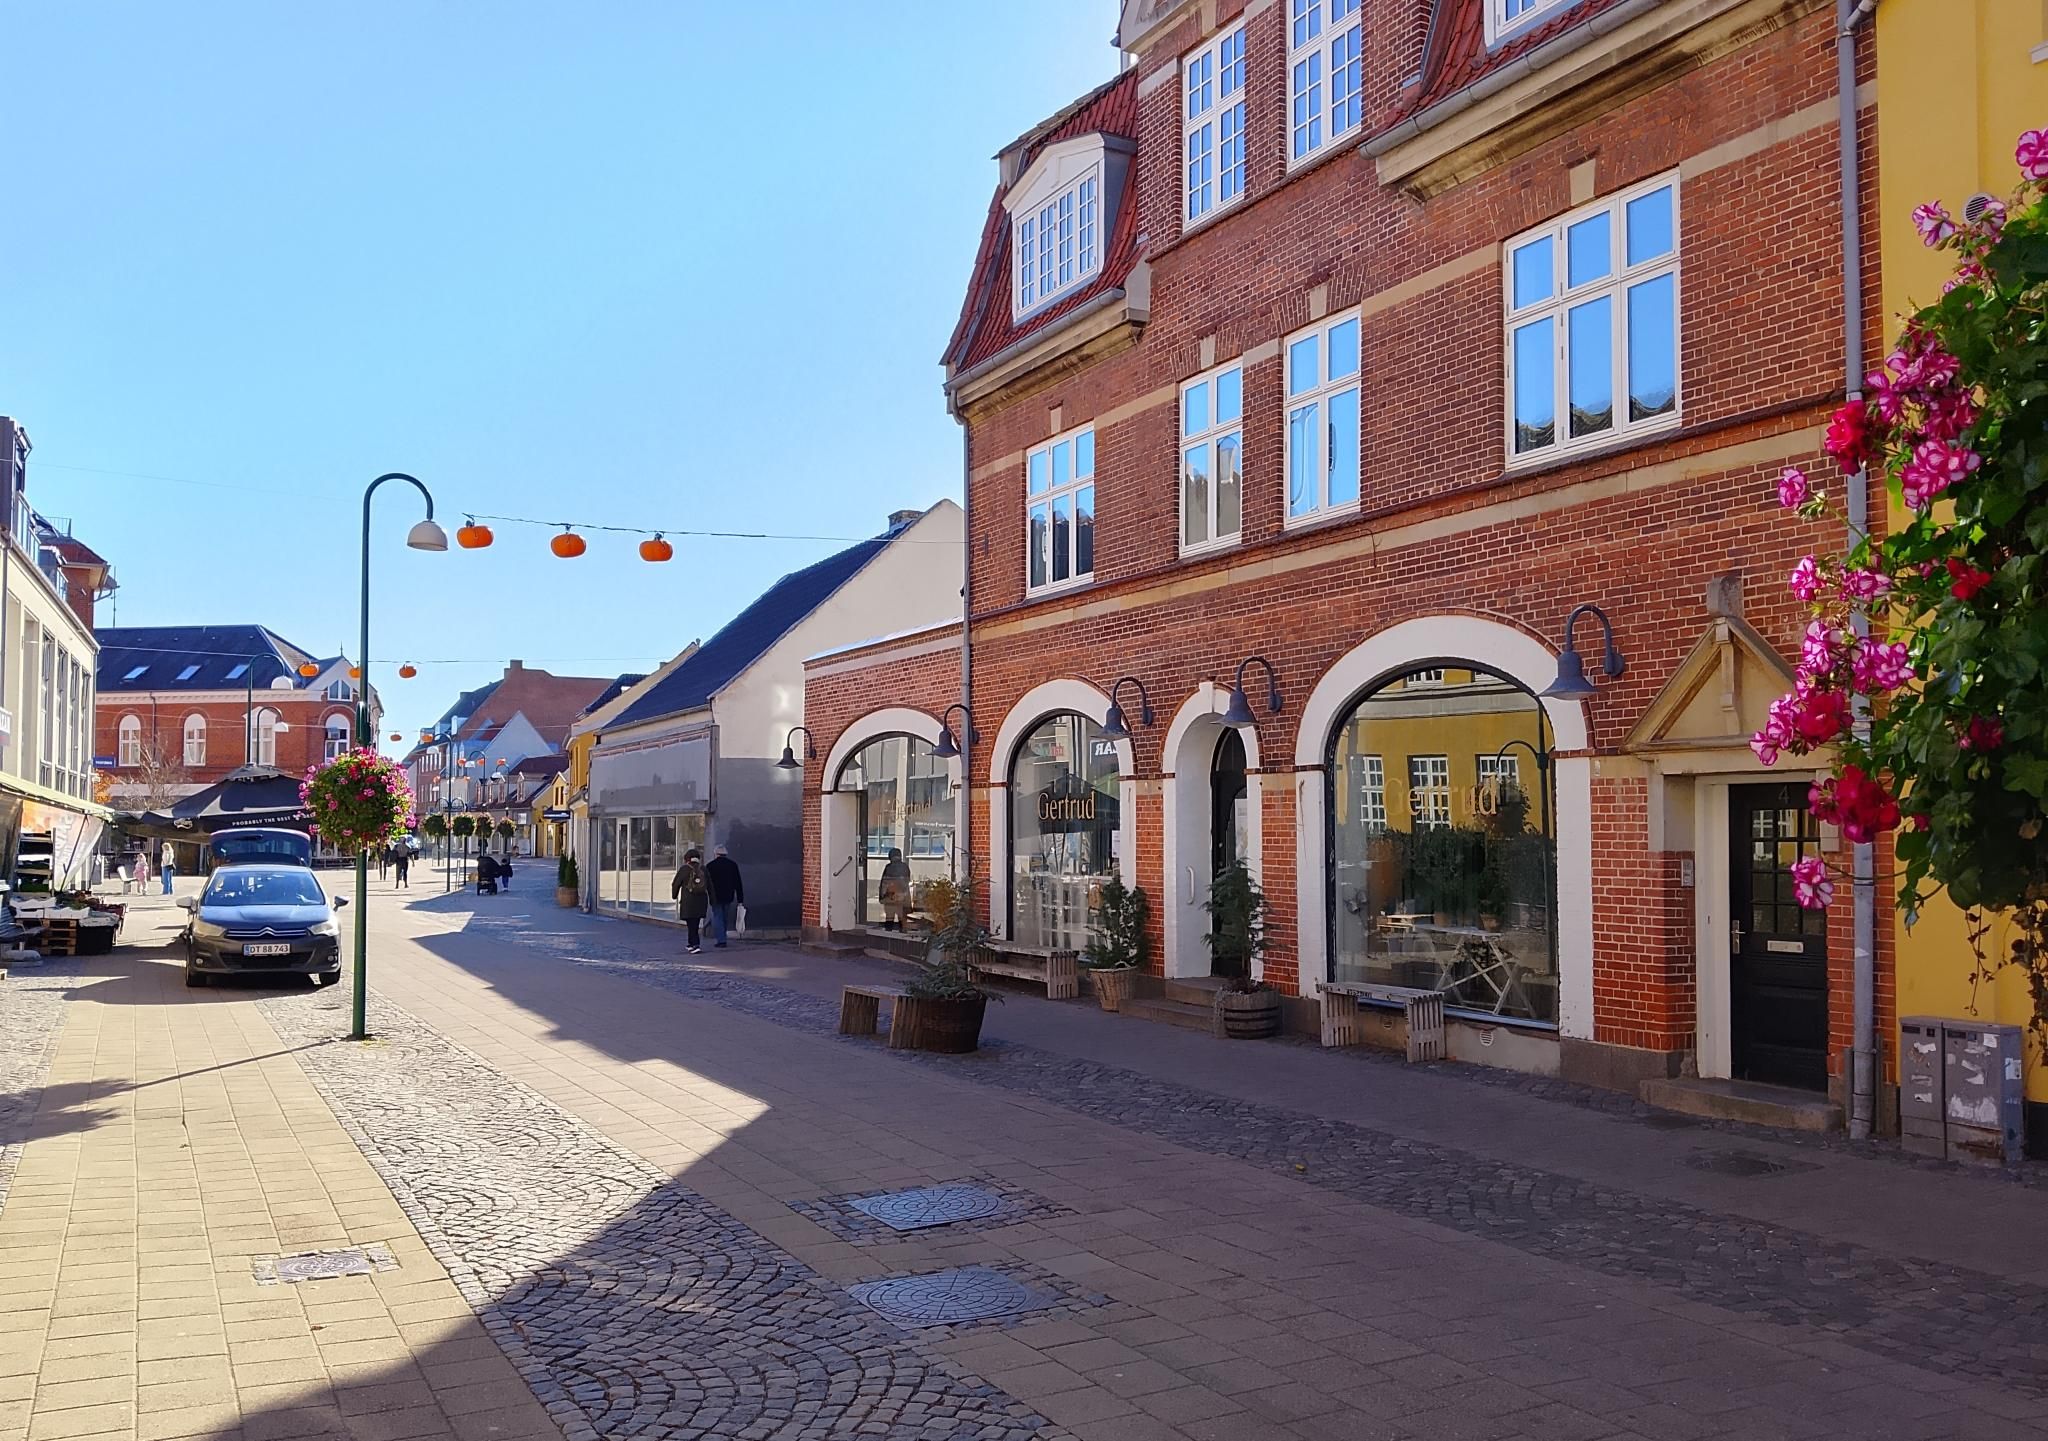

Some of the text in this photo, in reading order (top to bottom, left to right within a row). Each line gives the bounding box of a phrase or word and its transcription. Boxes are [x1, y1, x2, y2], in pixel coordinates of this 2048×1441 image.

[1038, 790, 1096, 820] Gertrud
[1383, 772, 1497, 816] Gertrud
[1778, 784, 1790, 804] 4
[274, 945, 289, 953] 743
